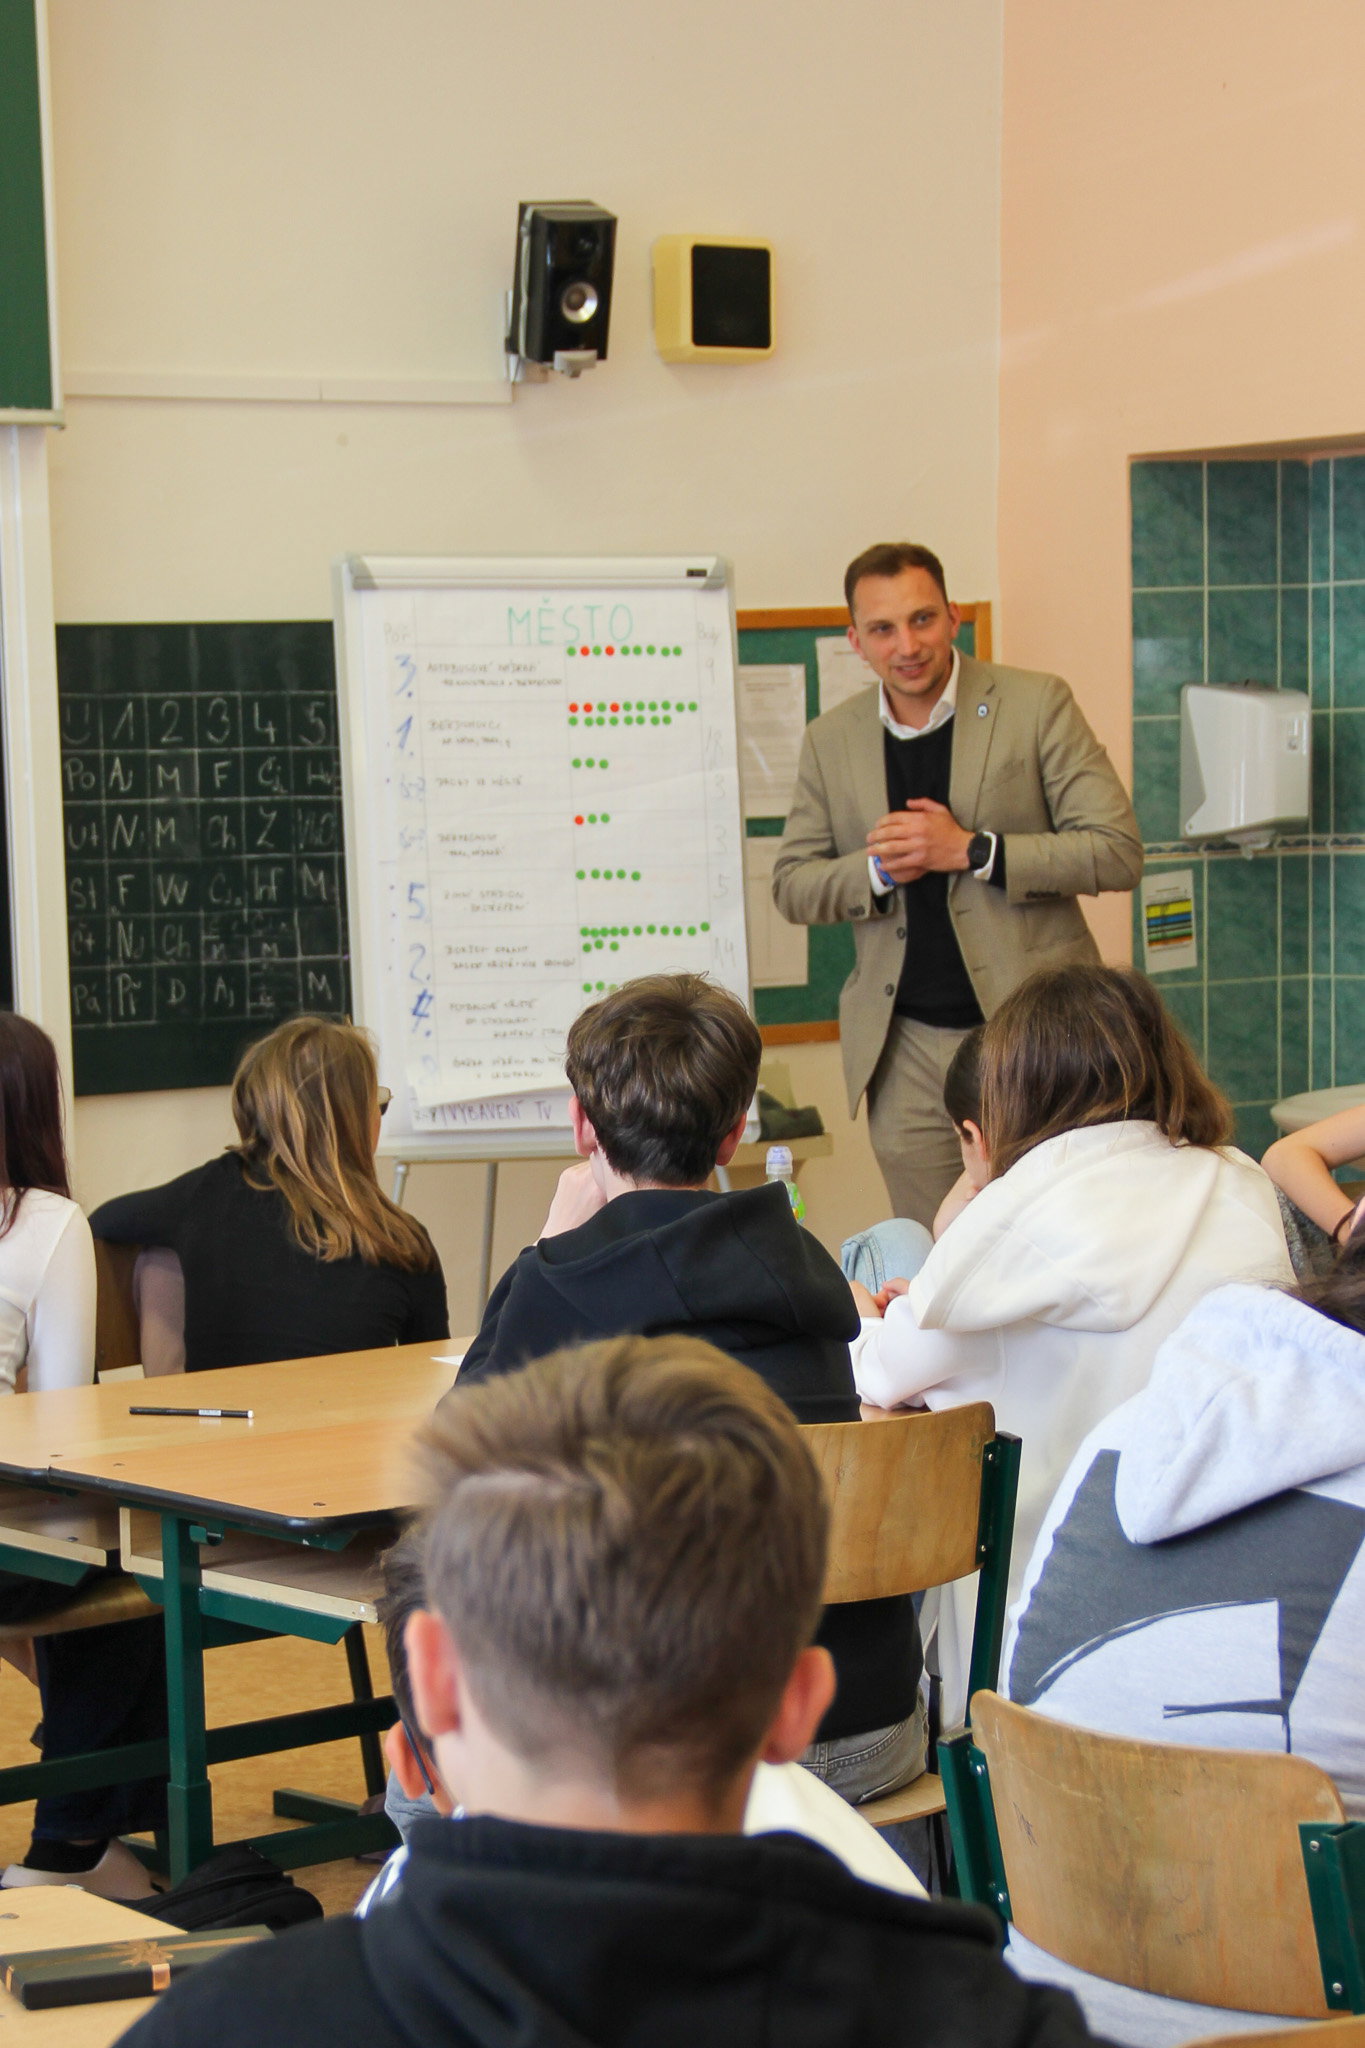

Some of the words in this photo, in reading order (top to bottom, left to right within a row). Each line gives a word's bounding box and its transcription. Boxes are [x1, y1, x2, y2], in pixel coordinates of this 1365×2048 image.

[507, 597, 634, 646] MĚSTO
[705, 657, 715, 686] 9
[113, 702, 134, 742] 1
[160, 701, 183, 743] 2
[207, 698, 230, 743] 3
[254, 702, 276, 743] 4
[301, 701, 326, 746] 5
[66, 758, 95, 792] Po
[157, 764, 181, 792] M
[213, 761, 231, 789] F
[713, 774, 727, 800] 3
[155, 817, 176, 848] M
[207, 814, 236, 849] Ch
[713, 825, 728, 855] 3
[70, 877, 96, 910] St
[116, 874, 135, 907] F
[302, 862, 329, 902] M
[713, 873, 730, 899] 5
[162, 925, 191, 958] Ch
[74, 982, 100, 1015] Pá
[308, 970, 332, 1000] M
